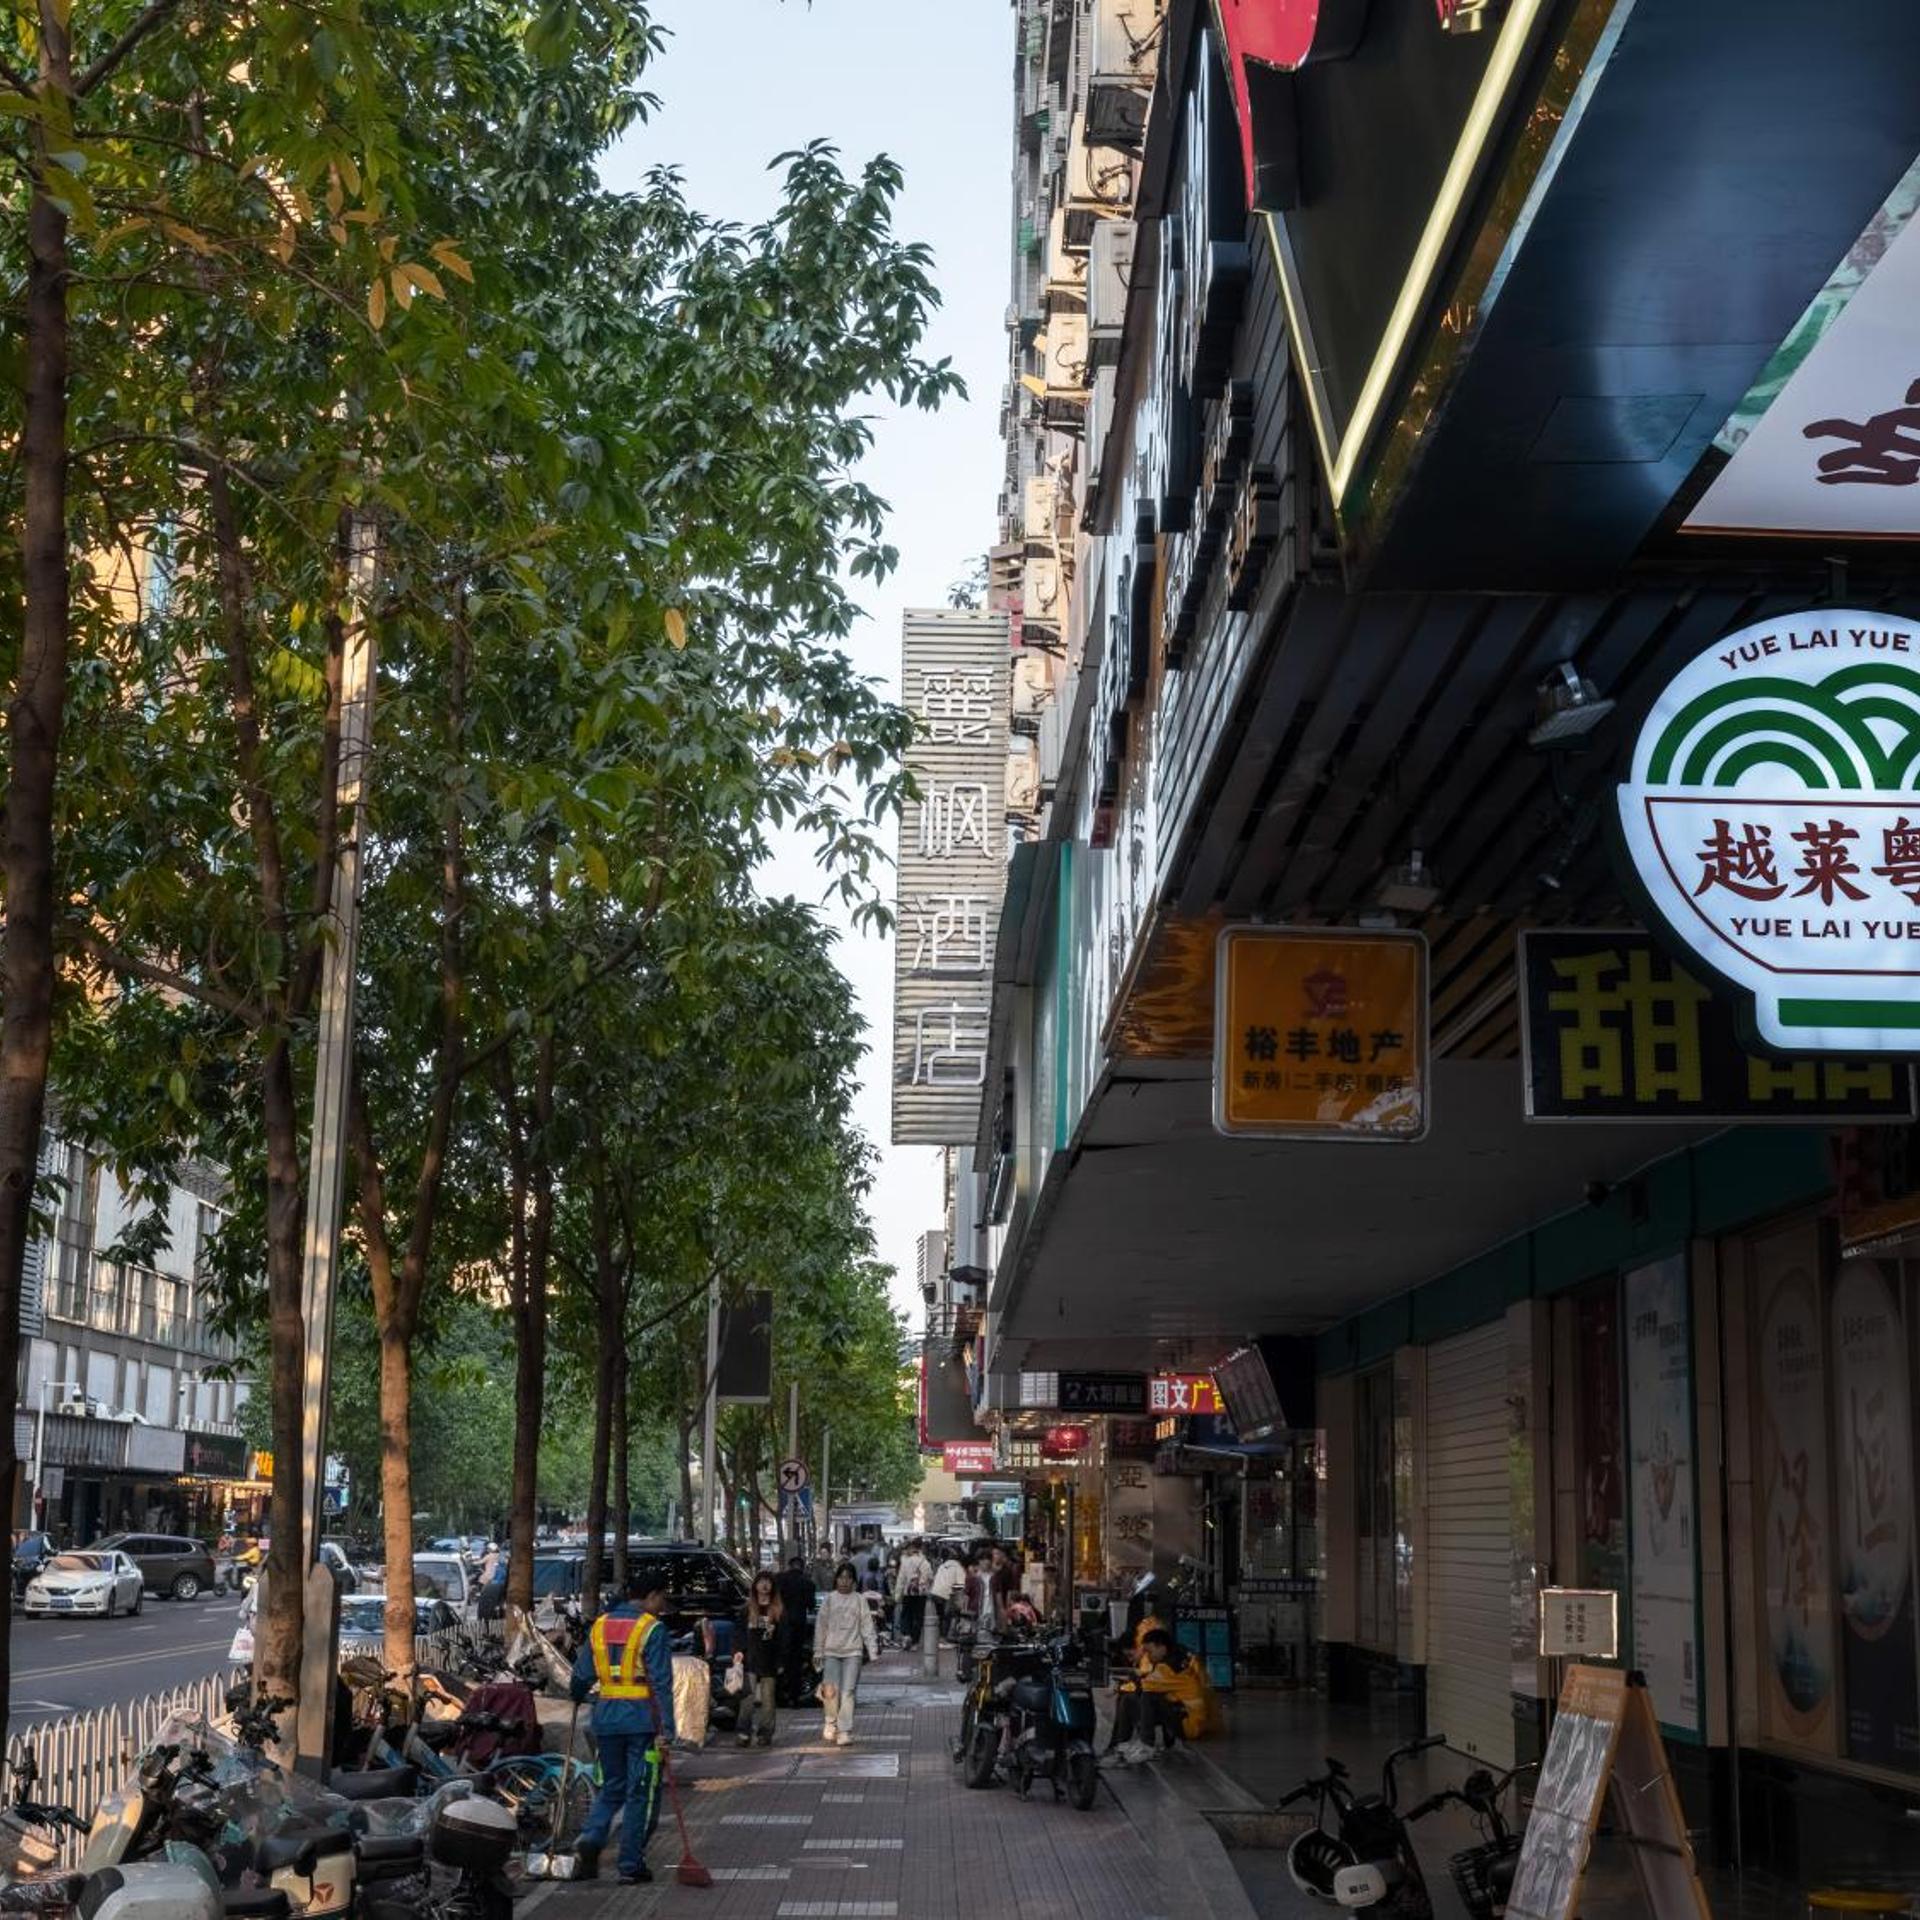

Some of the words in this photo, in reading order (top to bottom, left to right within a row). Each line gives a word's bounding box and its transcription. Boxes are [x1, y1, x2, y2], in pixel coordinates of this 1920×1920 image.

[1720, 634, 1781, 672] YUE
[1790, 629, 1840, 651] LAI
[1848, 629, 1911, 652] YUE
[1731, 917, 1792, 939] YUE
[1803, 918, 1852, 940] LAI
[1862, 919, 1920, 941] YUE
[1244, 1025, 1404, 1064] 裕丰地产
